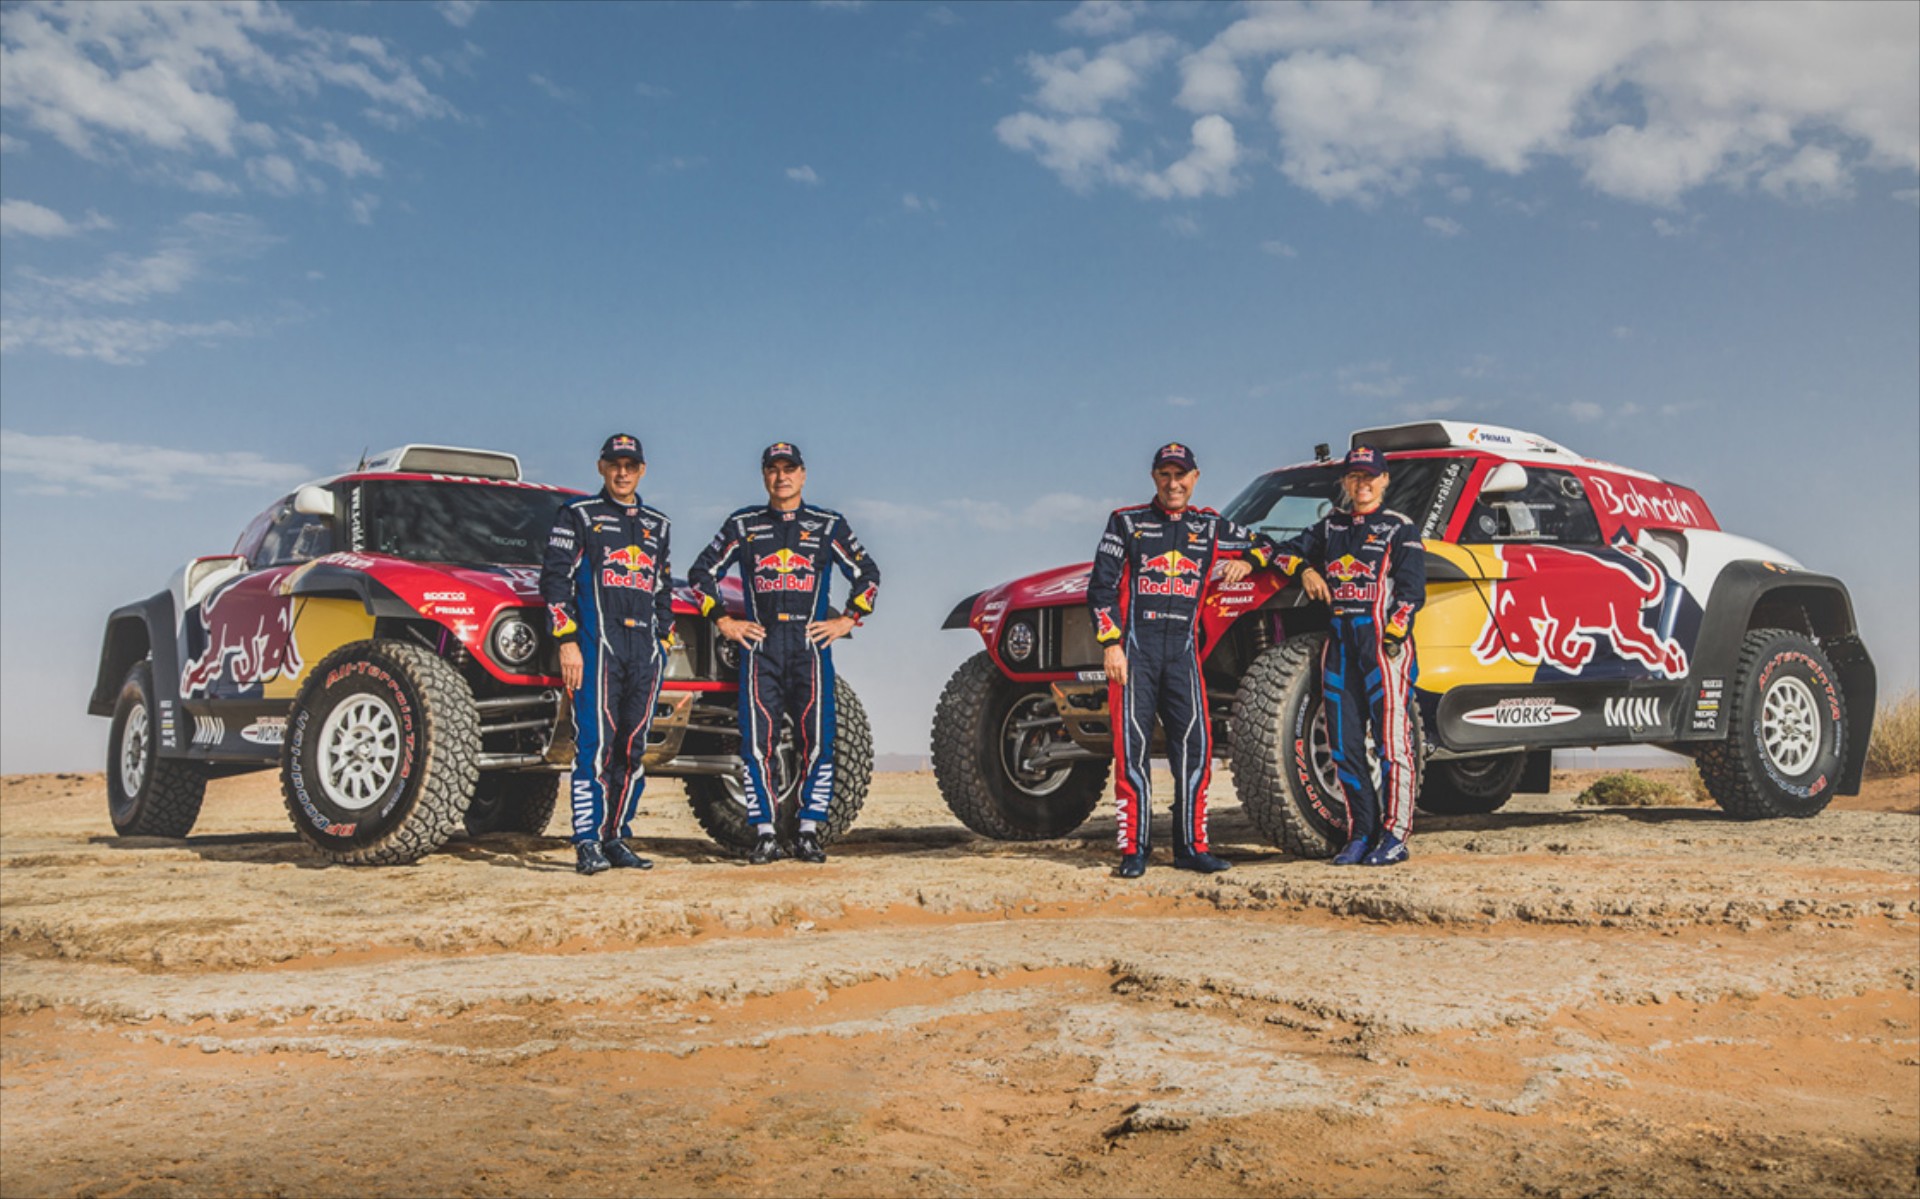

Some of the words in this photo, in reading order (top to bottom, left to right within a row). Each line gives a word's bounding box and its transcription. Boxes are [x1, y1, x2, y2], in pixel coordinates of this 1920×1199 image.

[1589, 475, 1699, 526] Bahrain
[603, 569, 632, 587] Red
[634, 571, 655, 593] Bul
[755, 574, 784, 593] Red
[786, 574, 815, 592] Bull
[1138, 576, 1171, 596] Red
[1173, 577, 1200, 598] Bull
[435, 606, 475, 616] PRIMAX
[1220, 596, 1255, 605] PRIMAX
[1496, 706, 1552, 723] WORKS
[1604, 697, 1662, 727] MINI
[192, 715, 226, 745] MINI
[257, 724, 288, 743] WORK
[808, 763, 833, 812] MINI
[573, 779, 595, 834] MINI
